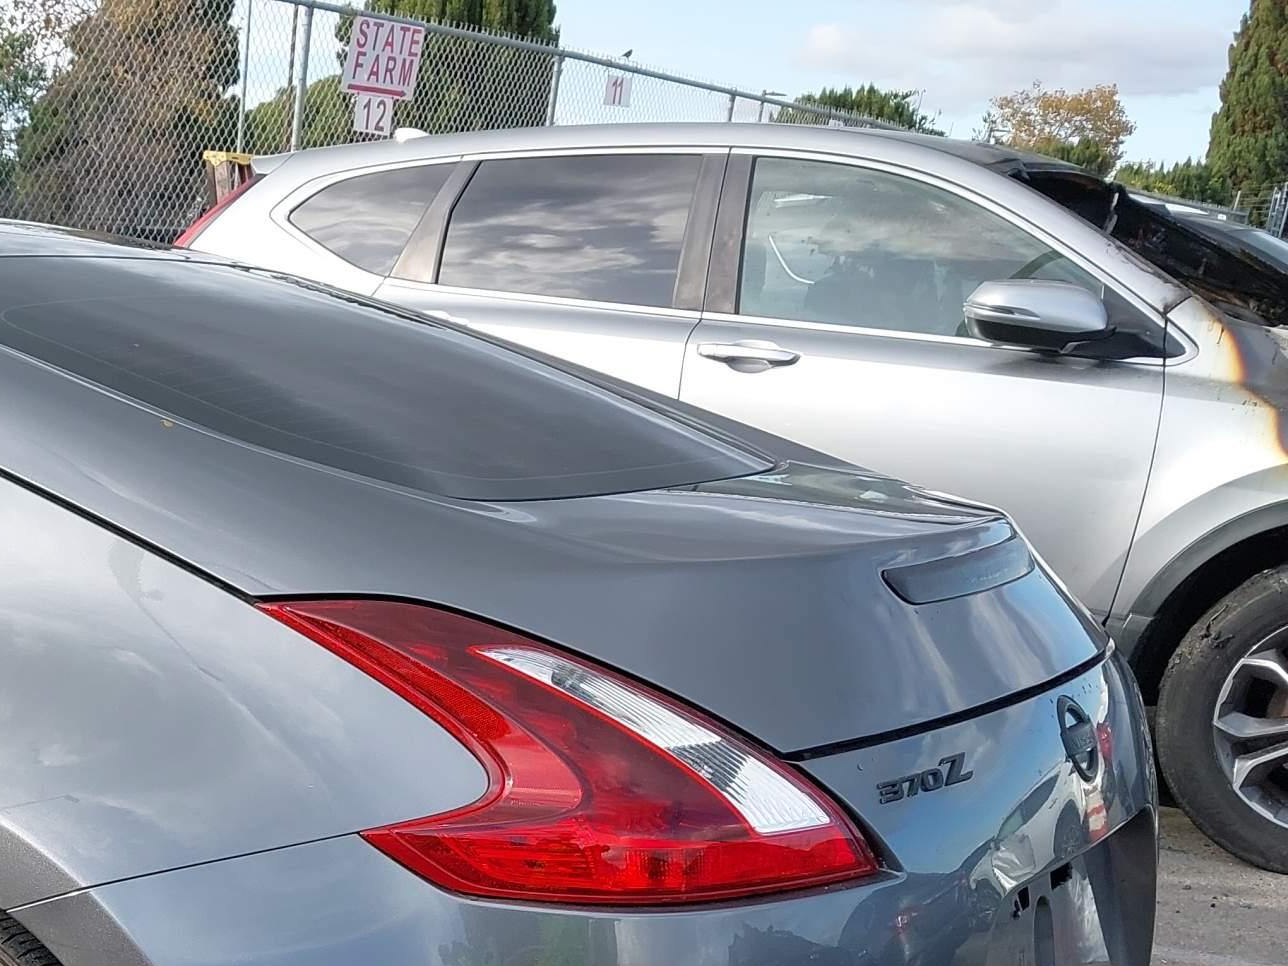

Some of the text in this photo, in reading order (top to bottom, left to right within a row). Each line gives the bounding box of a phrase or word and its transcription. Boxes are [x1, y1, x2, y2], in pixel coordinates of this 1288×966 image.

[356, 20, 423, 57] STATE
[352, 51, 414, 87] FARM
[612, 76, 624, 105] 11
[363, 97, 387, 132] 12
[876, 751, 974, 804] 370Z
